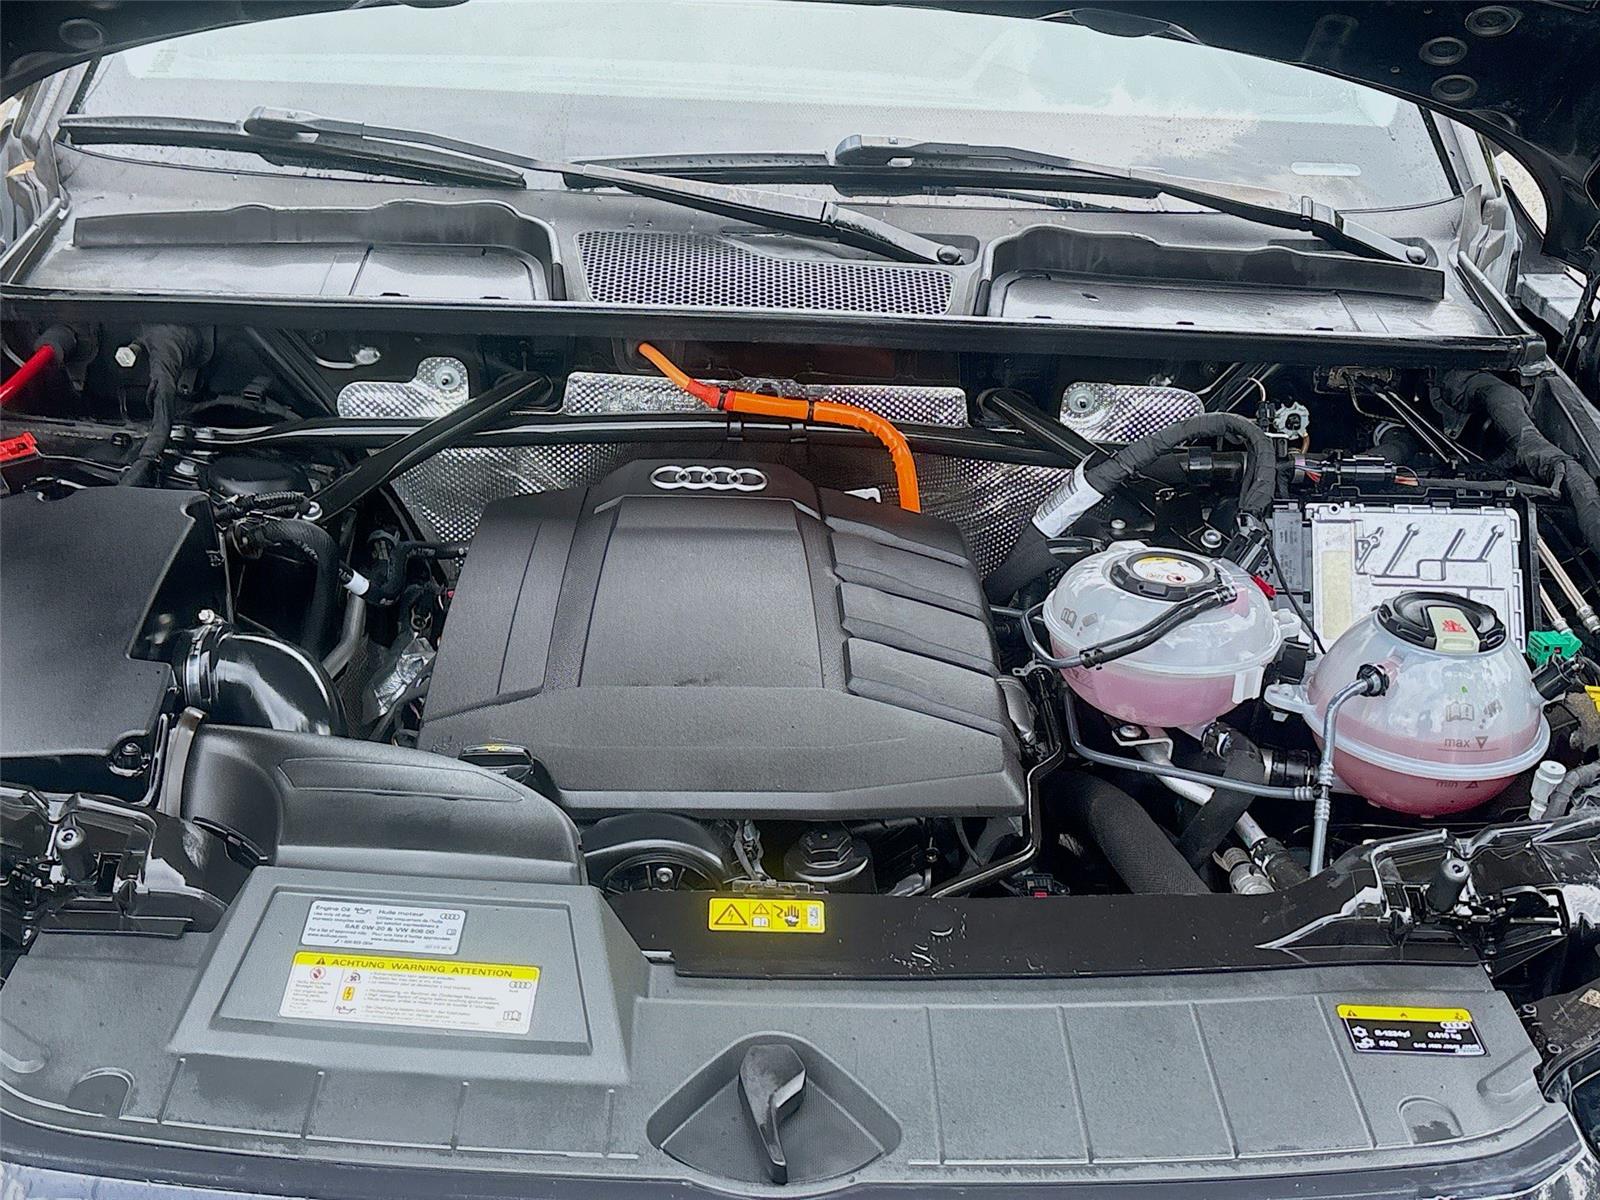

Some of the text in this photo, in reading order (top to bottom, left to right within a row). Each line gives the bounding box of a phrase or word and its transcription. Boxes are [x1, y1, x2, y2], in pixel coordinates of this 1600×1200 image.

[1444, 738, 1470, 748] max
[331, 958, 513, 978] ACHTUNG WARNING ATTENTION
